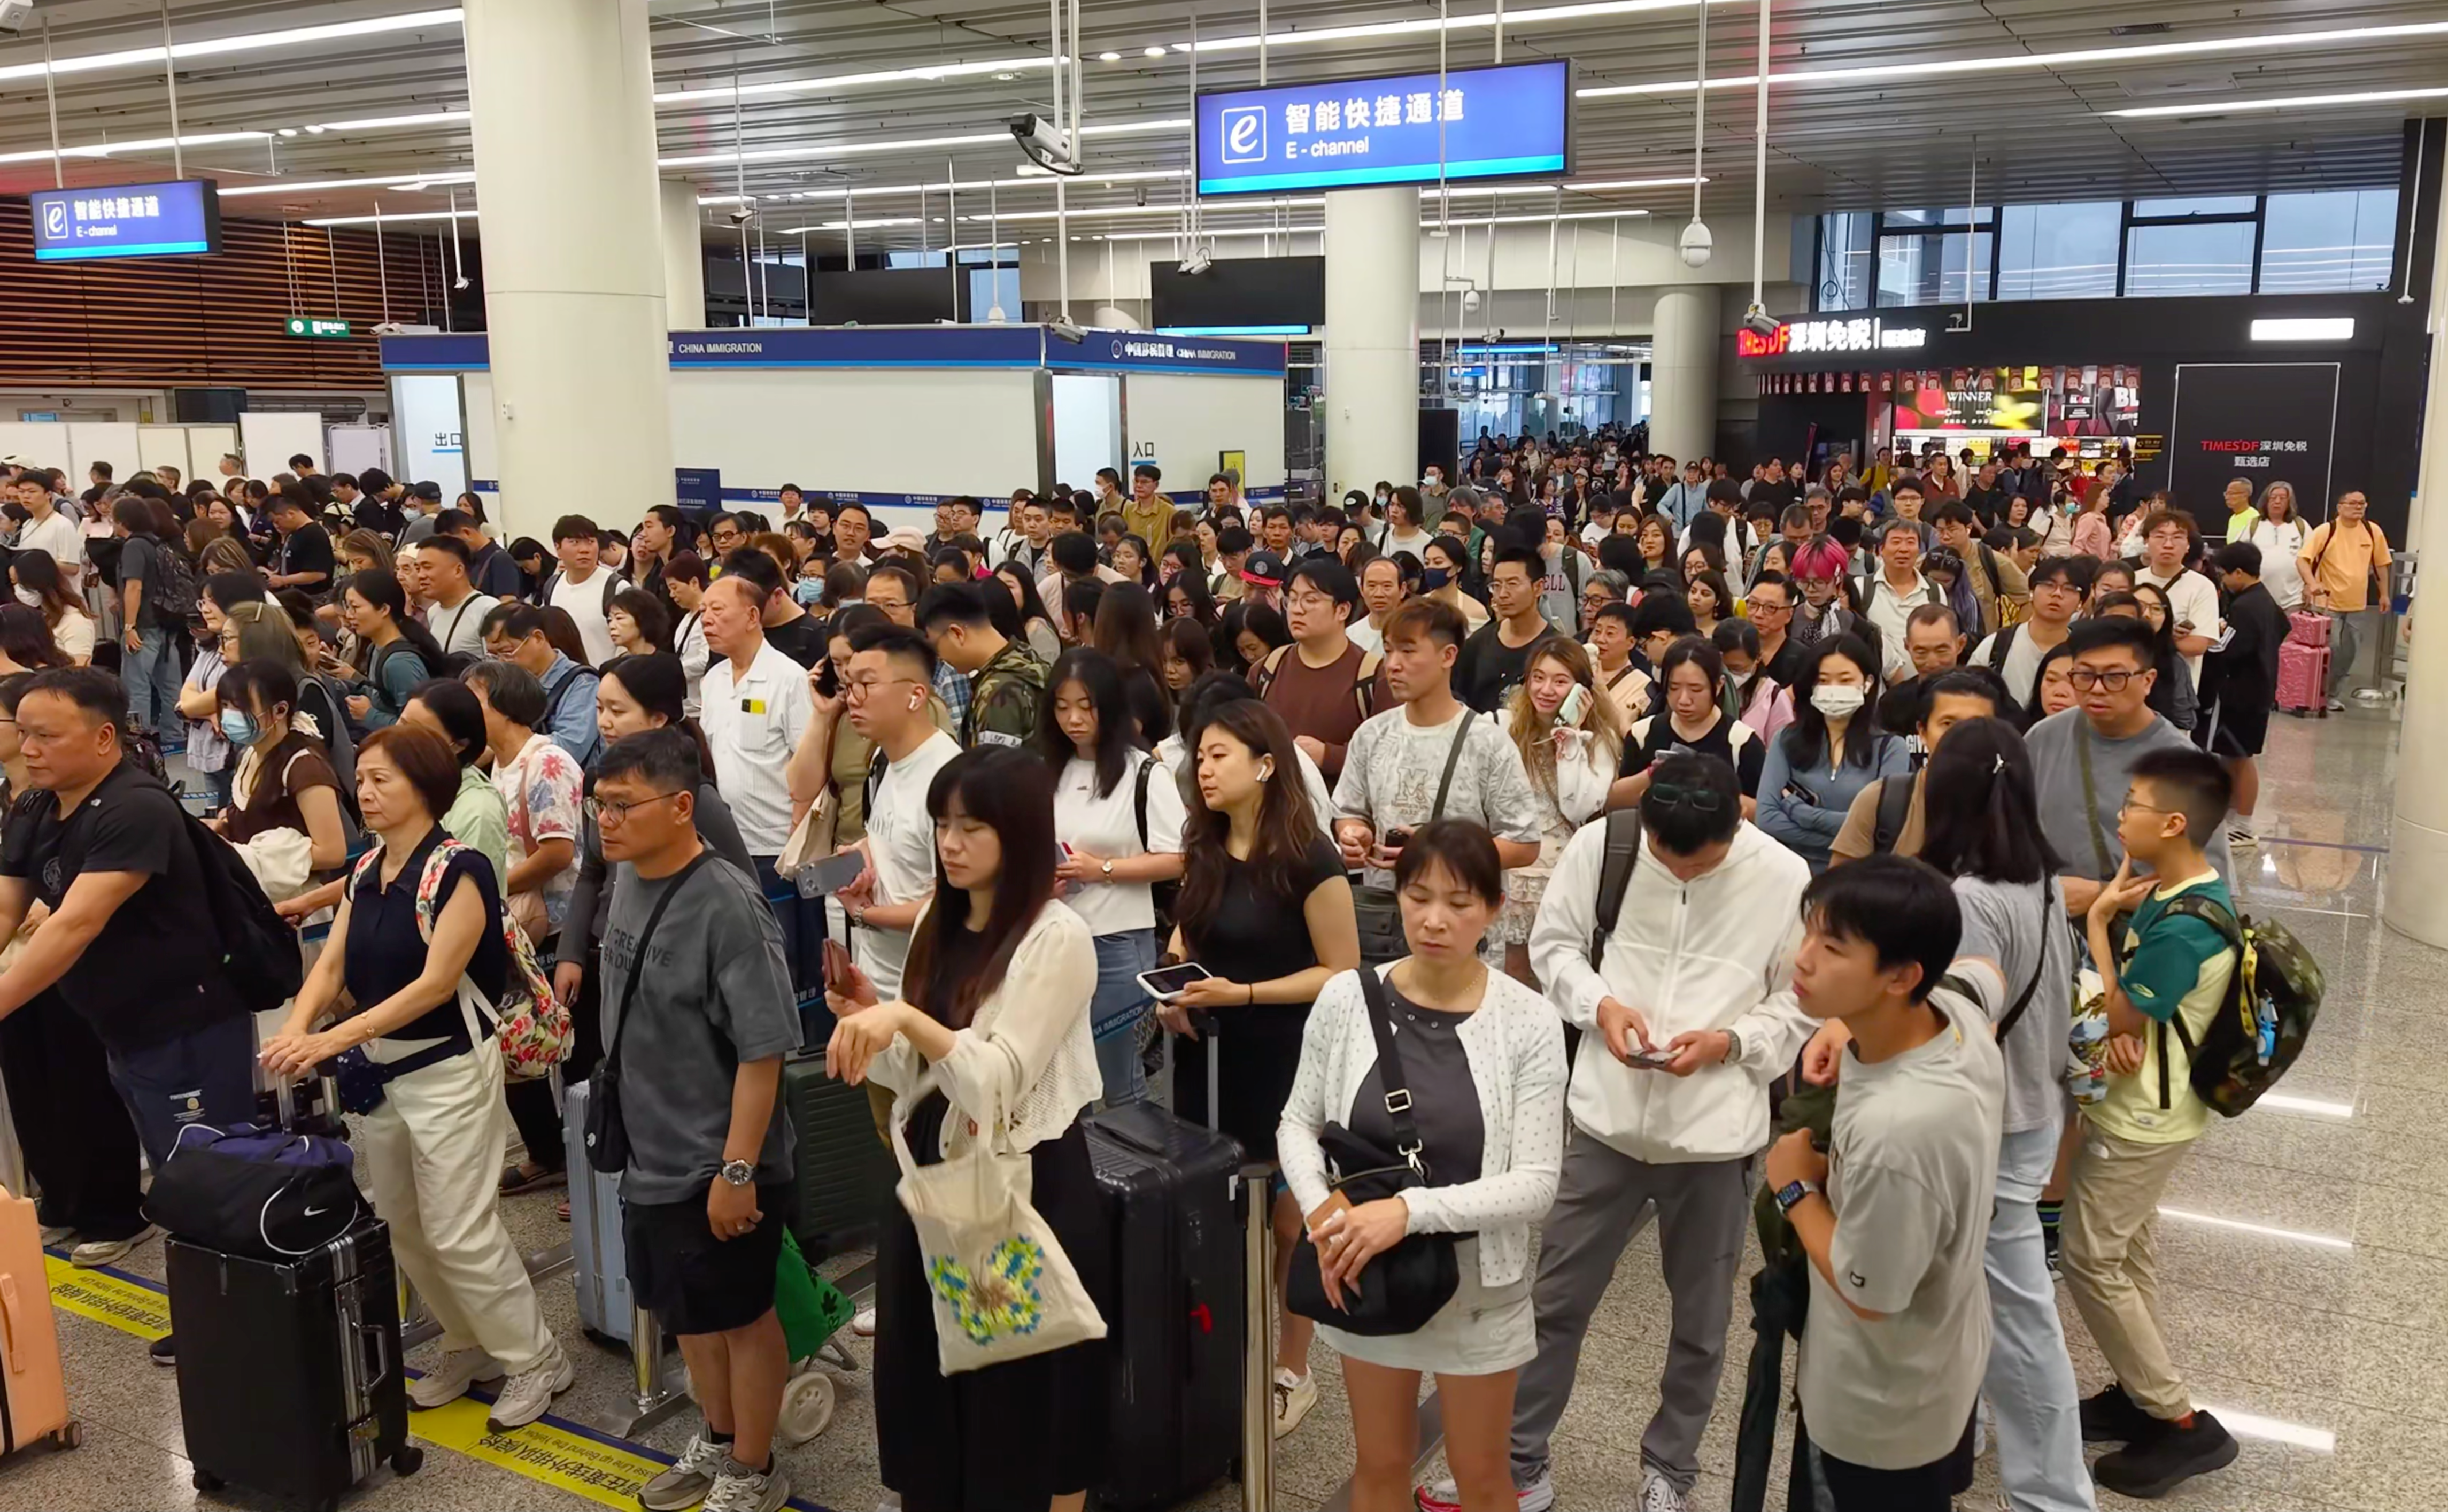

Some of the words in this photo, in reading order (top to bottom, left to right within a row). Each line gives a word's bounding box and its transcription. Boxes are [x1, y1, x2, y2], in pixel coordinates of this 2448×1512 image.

[1286, 89, 1464, 134] 智能快捷通道
[74, 195, 160, 221] 智能快捷通道
[1789, 318, 1872, 352] 深圳免税
[678, 344, 705, 354] CHINA
[706, 343, 762, 354] IMMIGRATION
[1124, 341, 1174, 358] 中国移民管理
[1176, 348, 1196, 359] CHINA
[1198, 349, 1237, 360] IMMIGRATION
[1947, 391, 1993, 402] WINNER
[435, 432, 462, 446] 出口
[2259, 440, 2307, 452] 深圳免税
[1133, 442, 1154, 458] 入口
[2234, 456, 2271, 467] 甄选店
